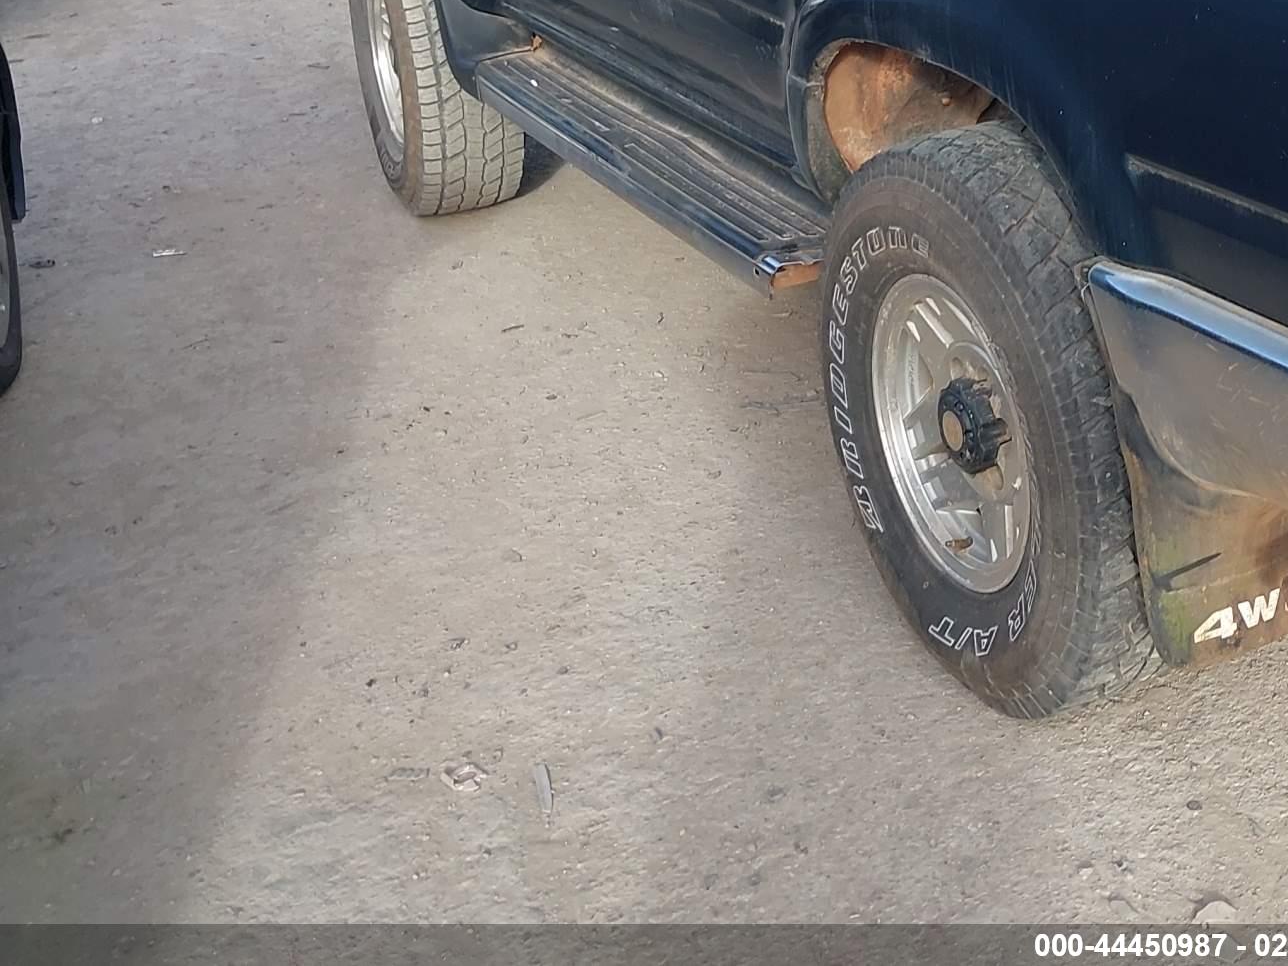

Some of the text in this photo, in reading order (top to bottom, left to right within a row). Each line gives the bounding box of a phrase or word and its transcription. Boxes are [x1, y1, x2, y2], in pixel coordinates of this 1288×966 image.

[829, 225, 930, 533] BRIDGESTONE
[927, 616, 999, 656] A/T
[1193, 587, 1288, 644] 4W
